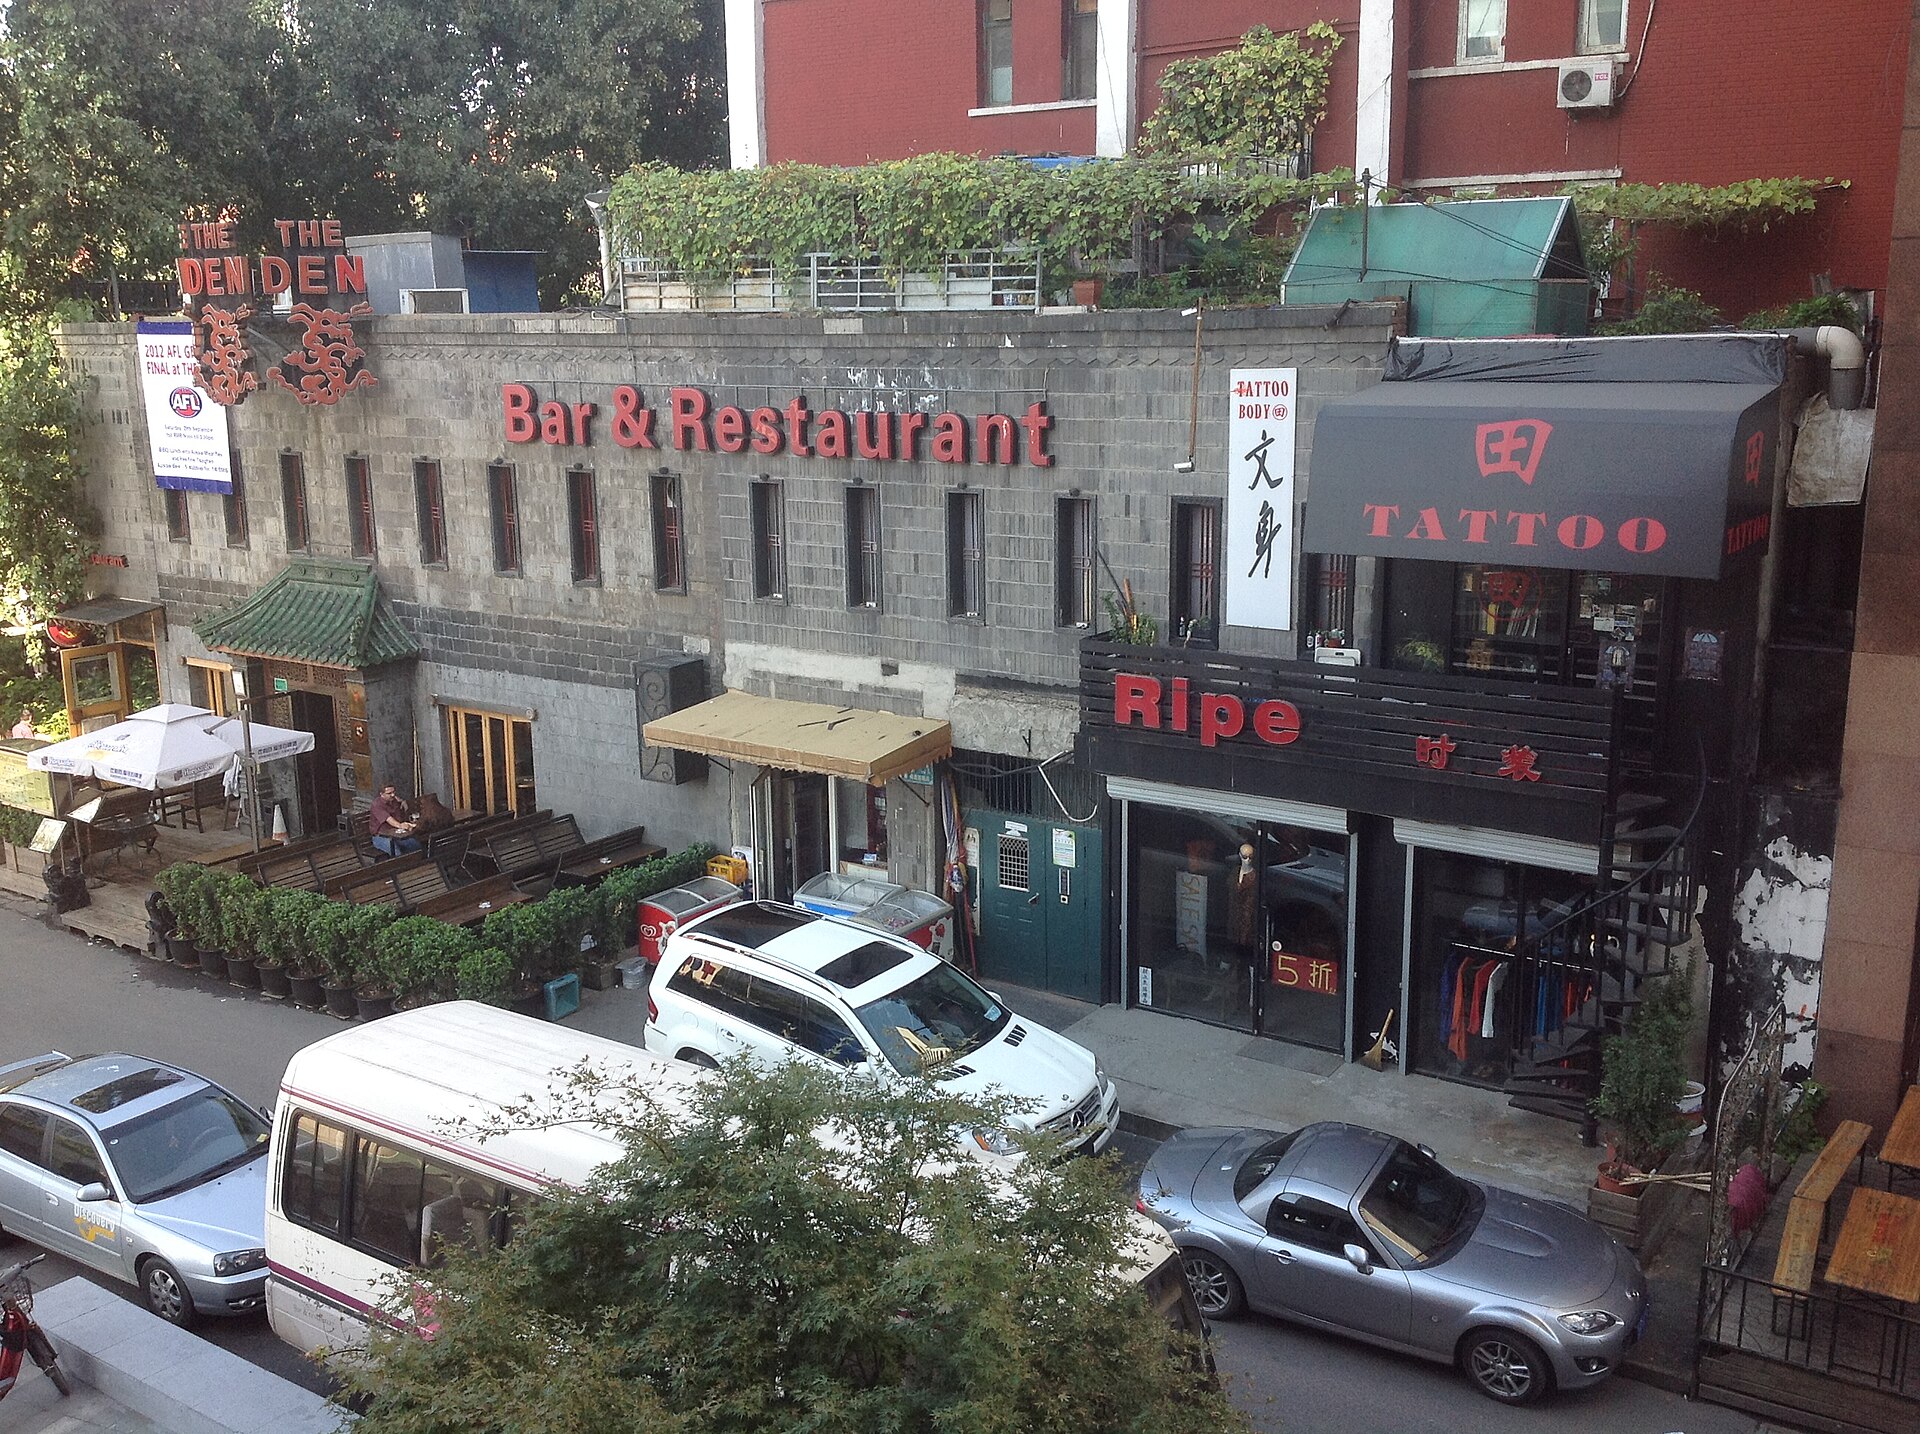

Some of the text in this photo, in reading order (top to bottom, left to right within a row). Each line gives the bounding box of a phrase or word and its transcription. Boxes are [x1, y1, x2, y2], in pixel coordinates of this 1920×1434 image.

[190, 222, 231, 249] THE
[274, 219, 344, 247] THE
[178, 256, 245, 296] DEN
[260, 255, 366, 294] DEN
[145, 344, 164, 358] 2012
[167, 345, 182, 358] AFL
[147, 361, 170, 375] FINAL
[172, 365, 180, 375] at
[172, 393, 200, 410] AFL
[1236, 380, 1289, 398] TATTOO
[501, 383, 1055, 467] Bar & Restaurant
[1238, 403, 1271, 420] BODY
[1244, 429, 1284, 579] 文身
[1362, 503, 1667, 553] TATTOO
[1113, 672, 1300, 747] Ripe
[1415, 733, 1542, 782] 时装
